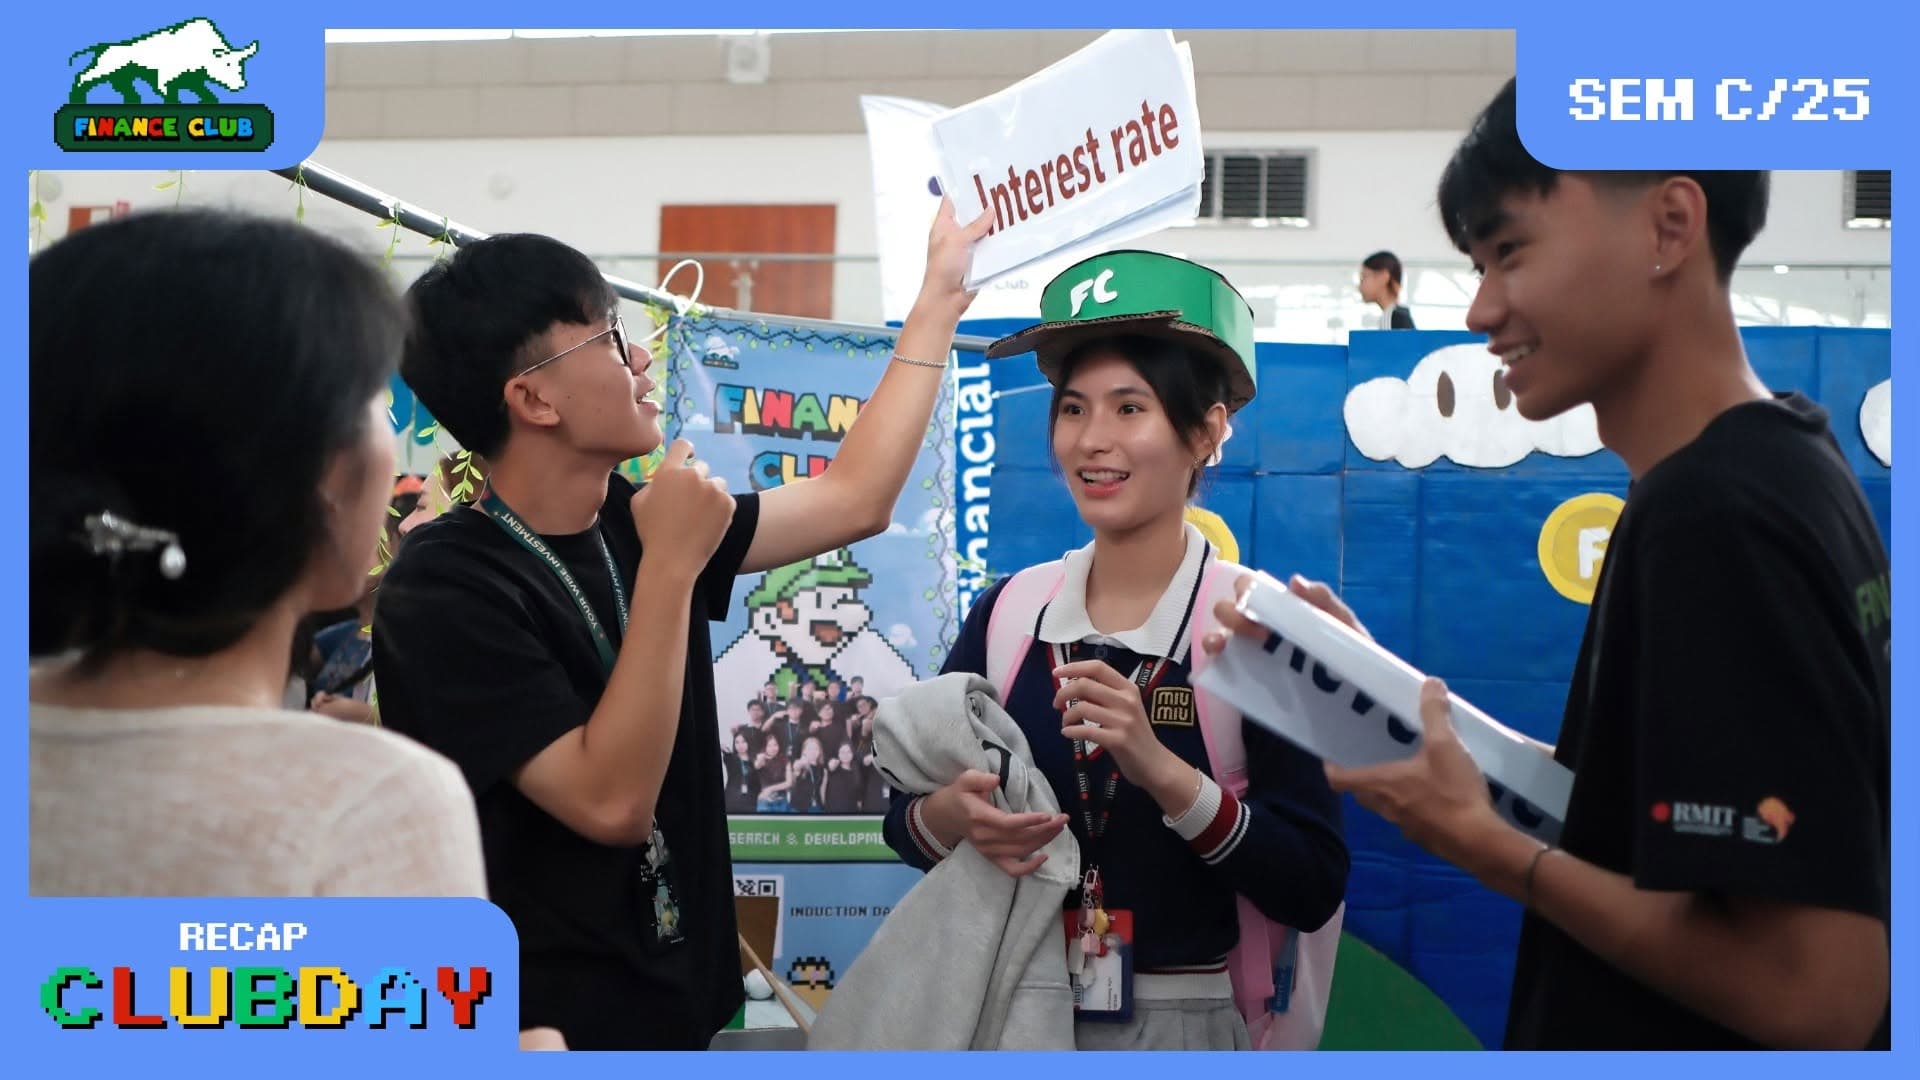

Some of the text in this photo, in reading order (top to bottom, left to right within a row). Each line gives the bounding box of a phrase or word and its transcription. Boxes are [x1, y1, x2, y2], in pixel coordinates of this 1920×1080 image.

[973, 99, 1179, 237] Interest rate
[1070, 268, 1118, 318] FC
[714, 382, 869, 442] FINAN
[501, 512, 598, 630] YOUR WISE INVESTMENT
[1673, 801, 1736, 826] RMIT
[728, 832, 780, 846] SEARCH
[804, 832, 884, 846] DEVELOPME
[790, 905, 892, 918] INDUCTION DA
